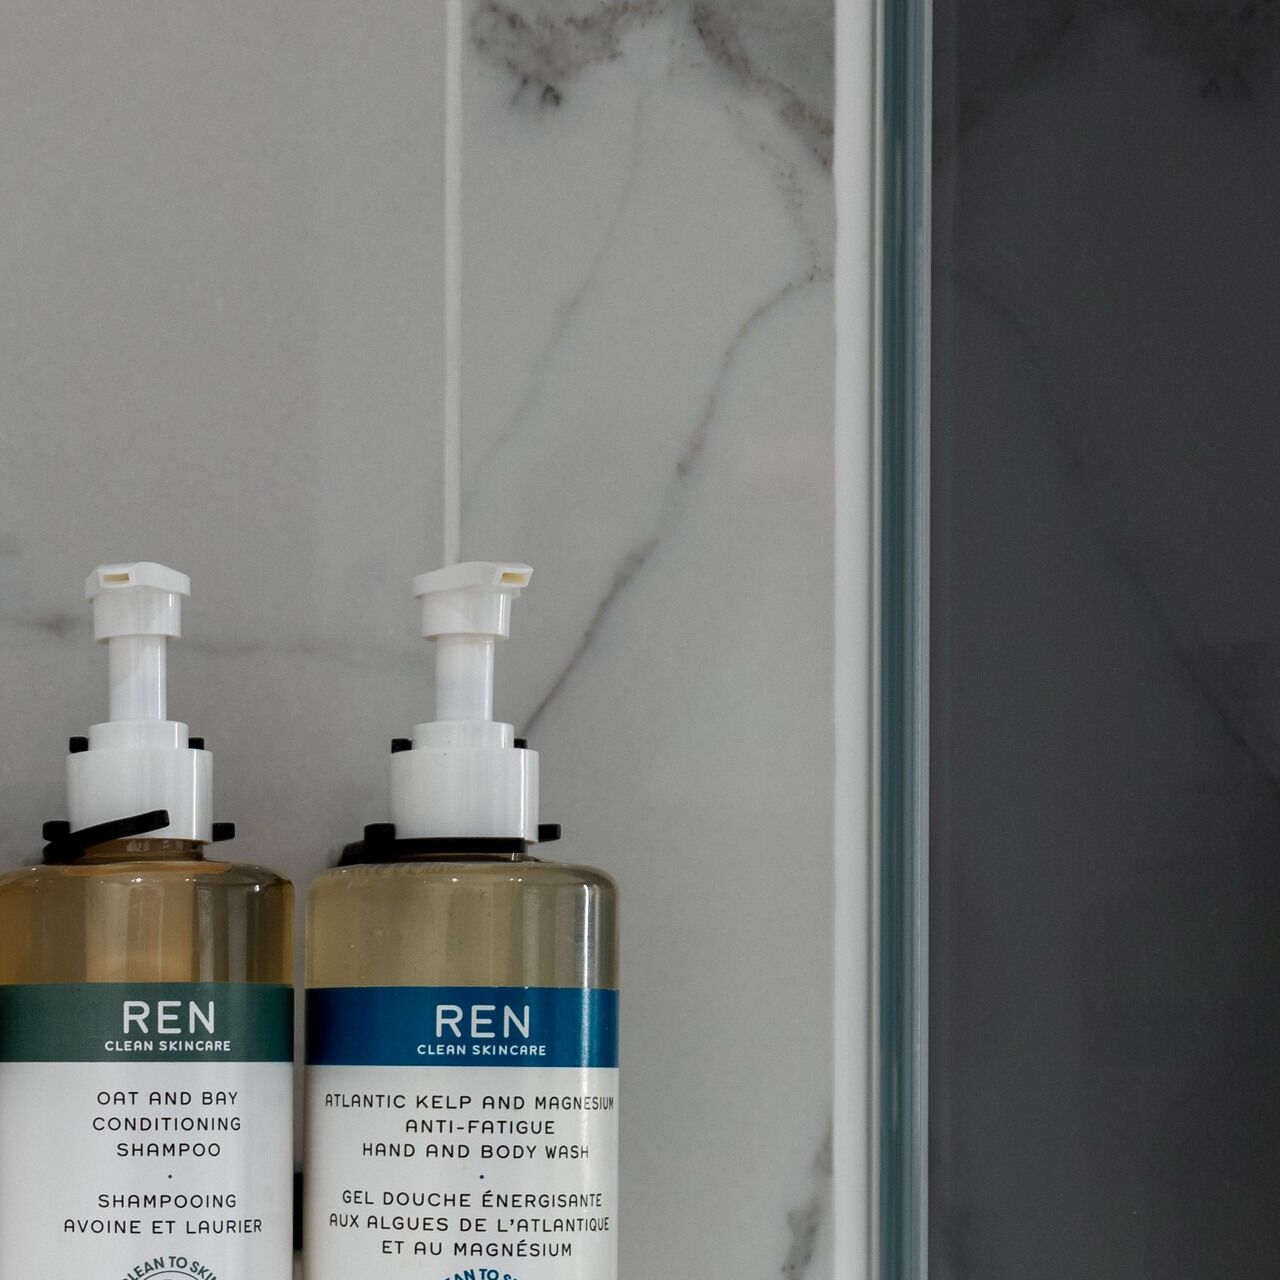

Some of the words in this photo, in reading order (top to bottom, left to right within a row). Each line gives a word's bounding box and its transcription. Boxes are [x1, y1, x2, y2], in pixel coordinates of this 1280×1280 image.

[123, 1000, 215, 1035] REN
[435, 1004, 530, 1039] REN
[104, 1040, 154, 1052] CLEAN
[158, 1040, 231, 1052] SKINCARE
[416, 1044, 466, 1056] CLEAN
[472, 1044, 547, 1057] SKINCARE
[96, 1091, 139, 1106] OAT
[149, 1091, 192, 1106] AND
[202, 1091, 238, 1106] BAY
[325, 1093, 406, 1109] ATLANTIC
[416, 1095, 472, 1110] KELP
[482, 1095, 525, 1110] AND
[534, 1095, 614, 1111] MAGNESIUM
[92, 1116, 241, 1132] CONDITIONING
[405, 1119, 555, 1135] ANTI-FATIGUE
[116, 1142, 221, 1158] SHAMPOO
[362, 1142, 416, 1158] HAND
[425, 1143, 470, 1159] AND
[480, 1144, 537, 1159] BODY
[544, 1144, 589, 1160] WASH
[98, 1193, 237, 1209] SHAMPOOING
[342, 1189, 375, 1205] GEL
[383, 1191, 472, 1208] DOUCHE
[481, 1189, 603, 1209] ÉNERGISANTE
[63, 1218, 142, 1235] AVOINE
[151, 1220, 176, 1235] ET
[186, 1218, 262, 1235] LAURIER
[329, 1212, 360, 1229] AUX
[367, 1215, 449, 1232] ALGUES
[459, 1217, 487, 1233] DE
[382, 1239, 405, 1255] ET
[414, 1241, 442, 1256] AU
[453, 1239, 572, 1258] MAGNÉSIUM
[169, 1256, 189, 1269] TO
